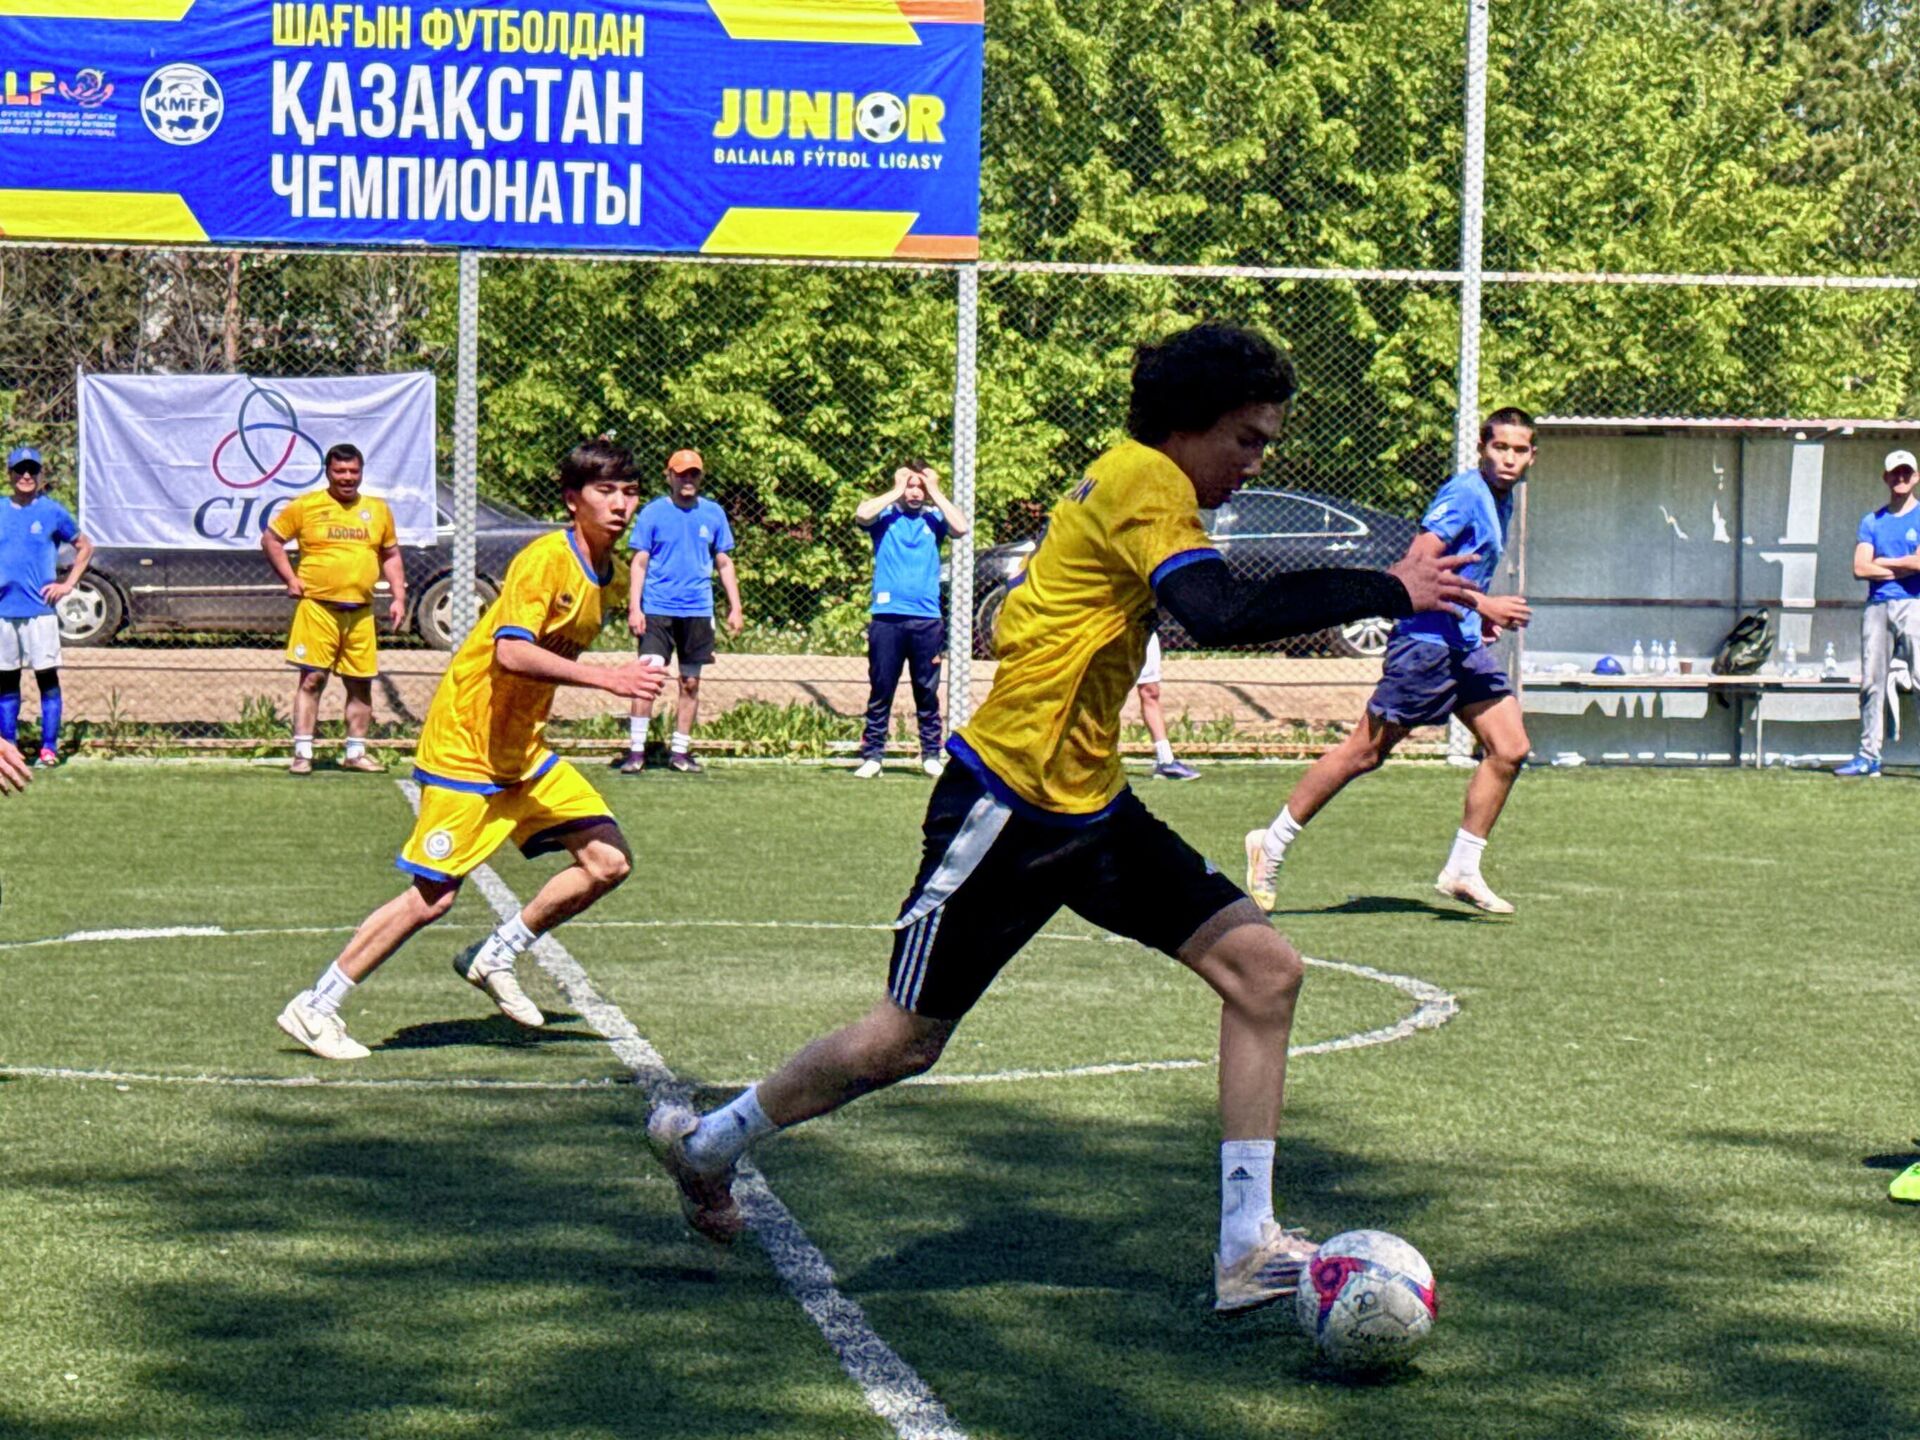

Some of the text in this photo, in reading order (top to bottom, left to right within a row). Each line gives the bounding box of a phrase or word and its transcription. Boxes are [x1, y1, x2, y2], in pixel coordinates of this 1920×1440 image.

[272, 2, 645, 61] ШАҒЫН ФУТБОЛДАН
[0, 71, 56, 106] LF
[155, 96, 210, 112] KMFF
[271, 60, 644, 150] ҚАЗАҚСТАН
[712, 88, 946, 143] JUNIOR
[713, 147, 796, 167] BALALAR
[879, 152, 943, 170] LIGASY
[271, 153, 642, 226] ЧЕМПИОНАТЫ
